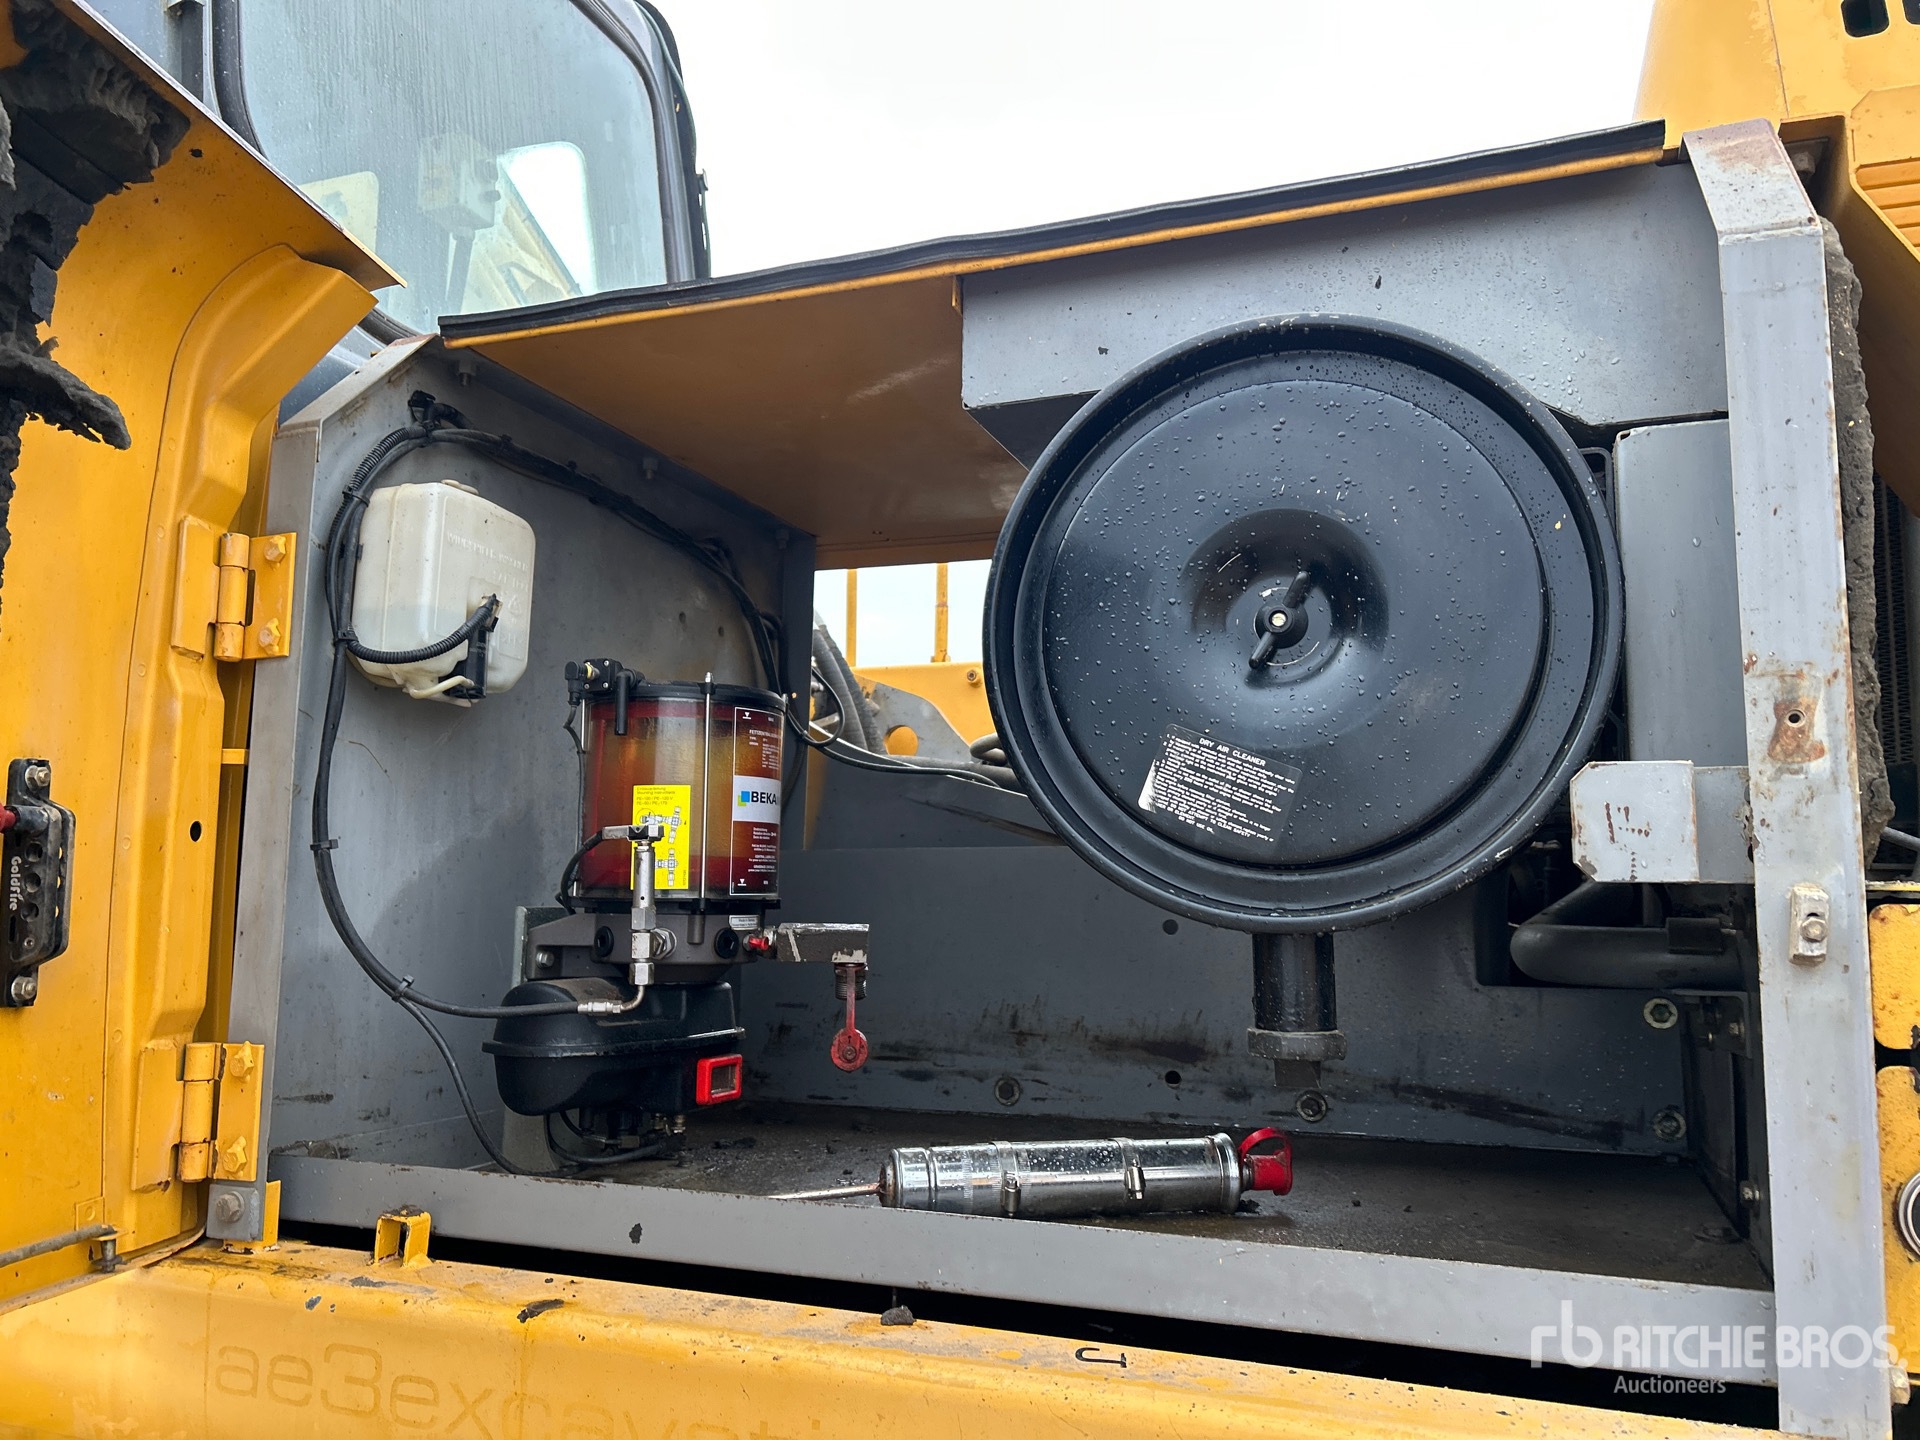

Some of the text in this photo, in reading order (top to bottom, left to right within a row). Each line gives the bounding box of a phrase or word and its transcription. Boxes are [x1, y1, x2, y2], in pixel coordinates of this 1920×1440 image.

[1199, 737, 1266, 767] DRY AIR CLEANER
[750, 790, 777, 806] BEKA
[9, 855, 24, 911] Goldfire
